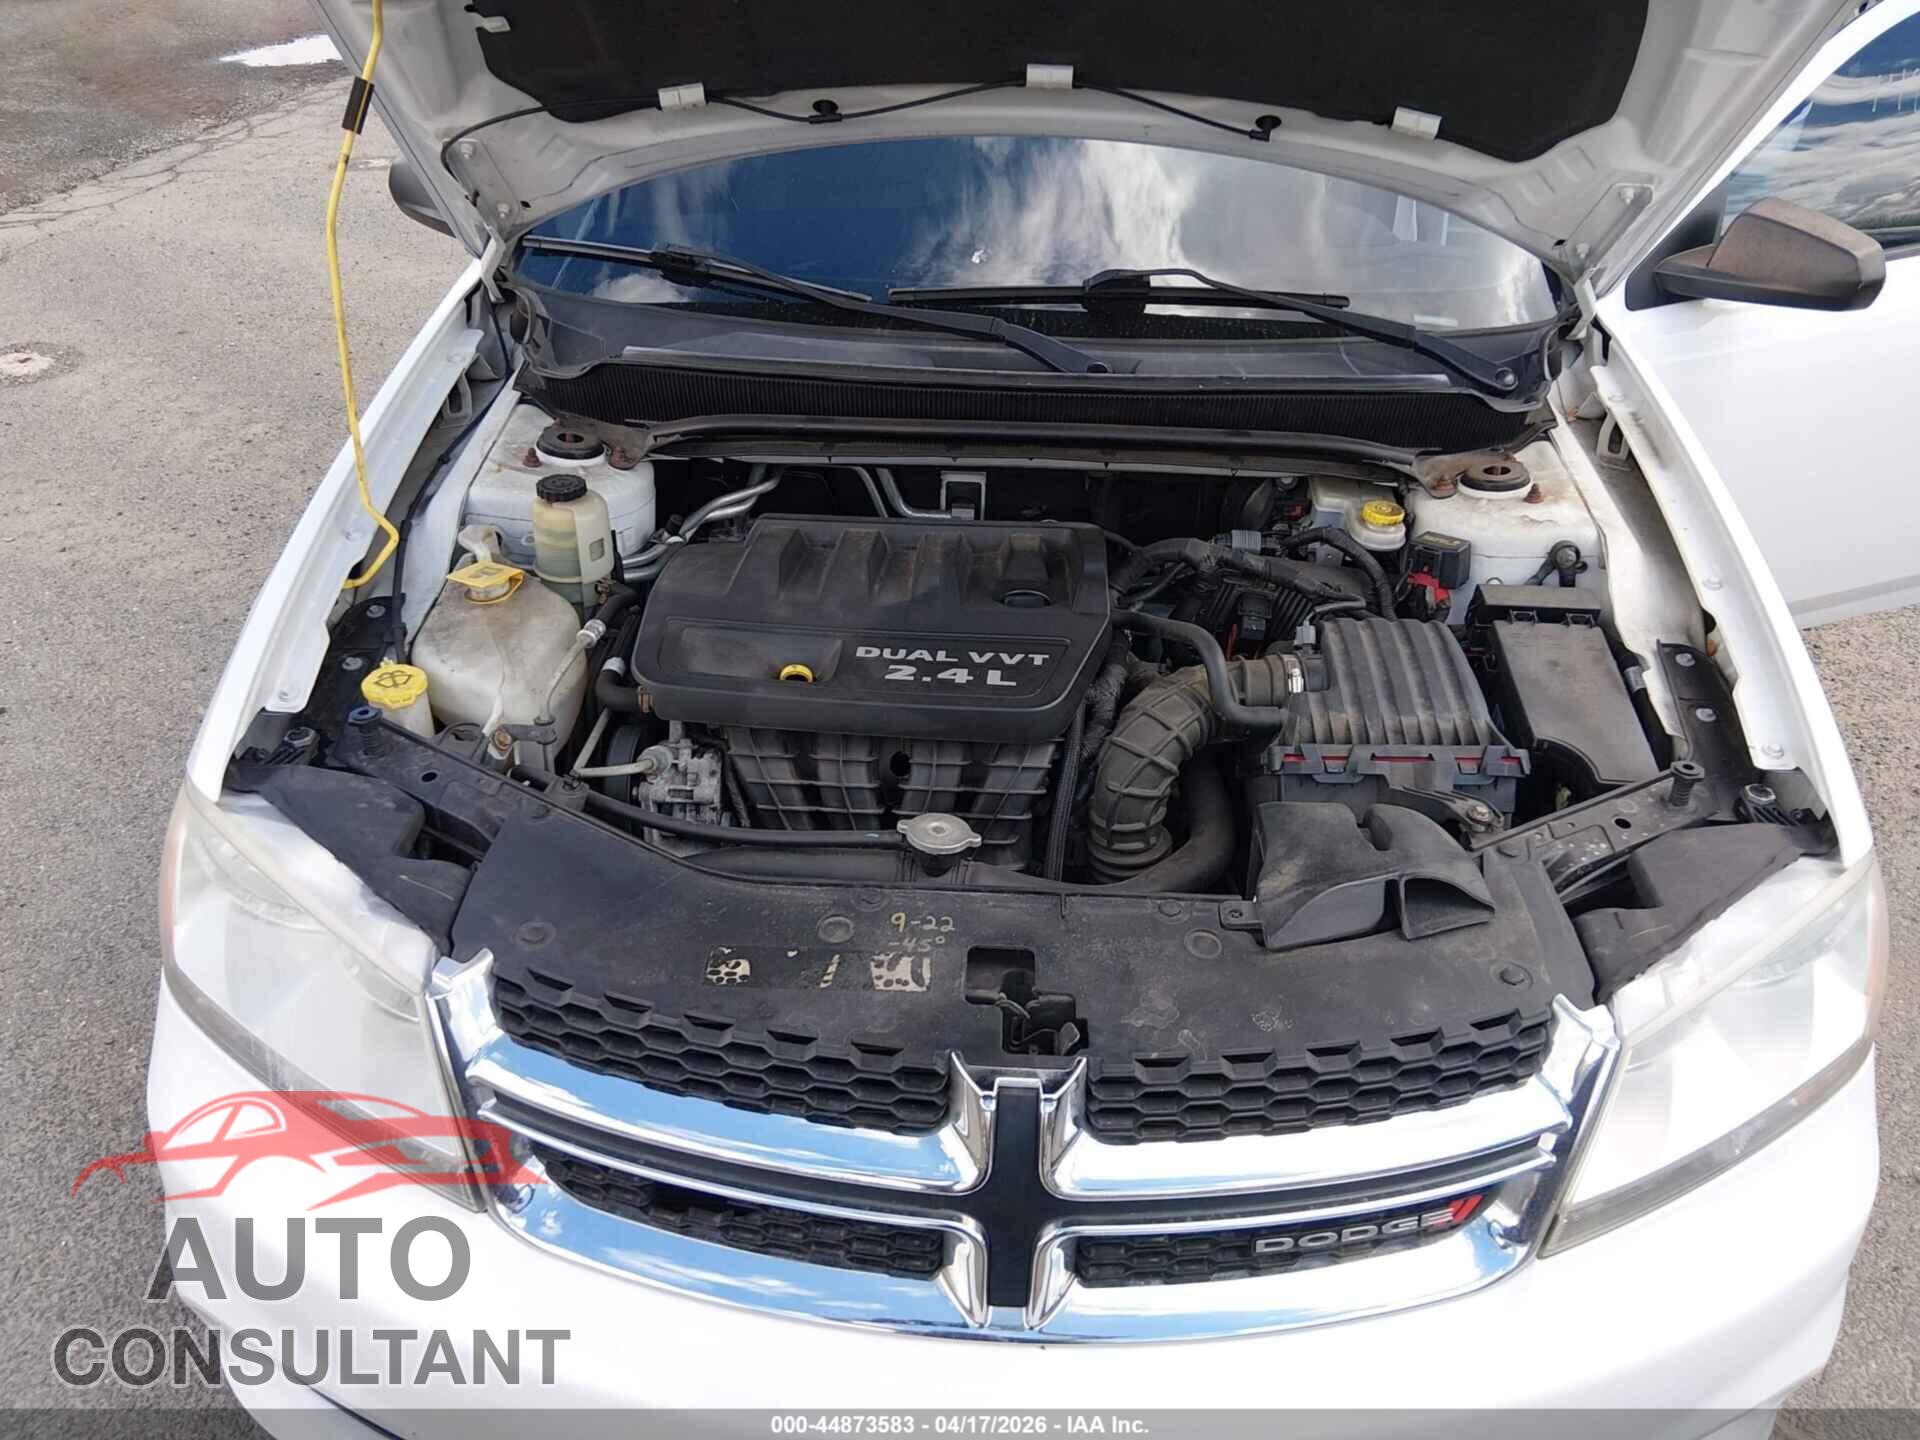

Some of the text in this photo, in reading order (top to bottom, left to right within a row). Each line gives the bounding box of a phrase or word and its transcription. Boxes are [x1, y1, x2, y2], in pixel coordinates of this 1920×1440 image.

[856, 646, 1050, 666] DUAL VVT
[890, 912, 955, 932] 9-22
[1255, 1207, 1454, 1253] DODGE
